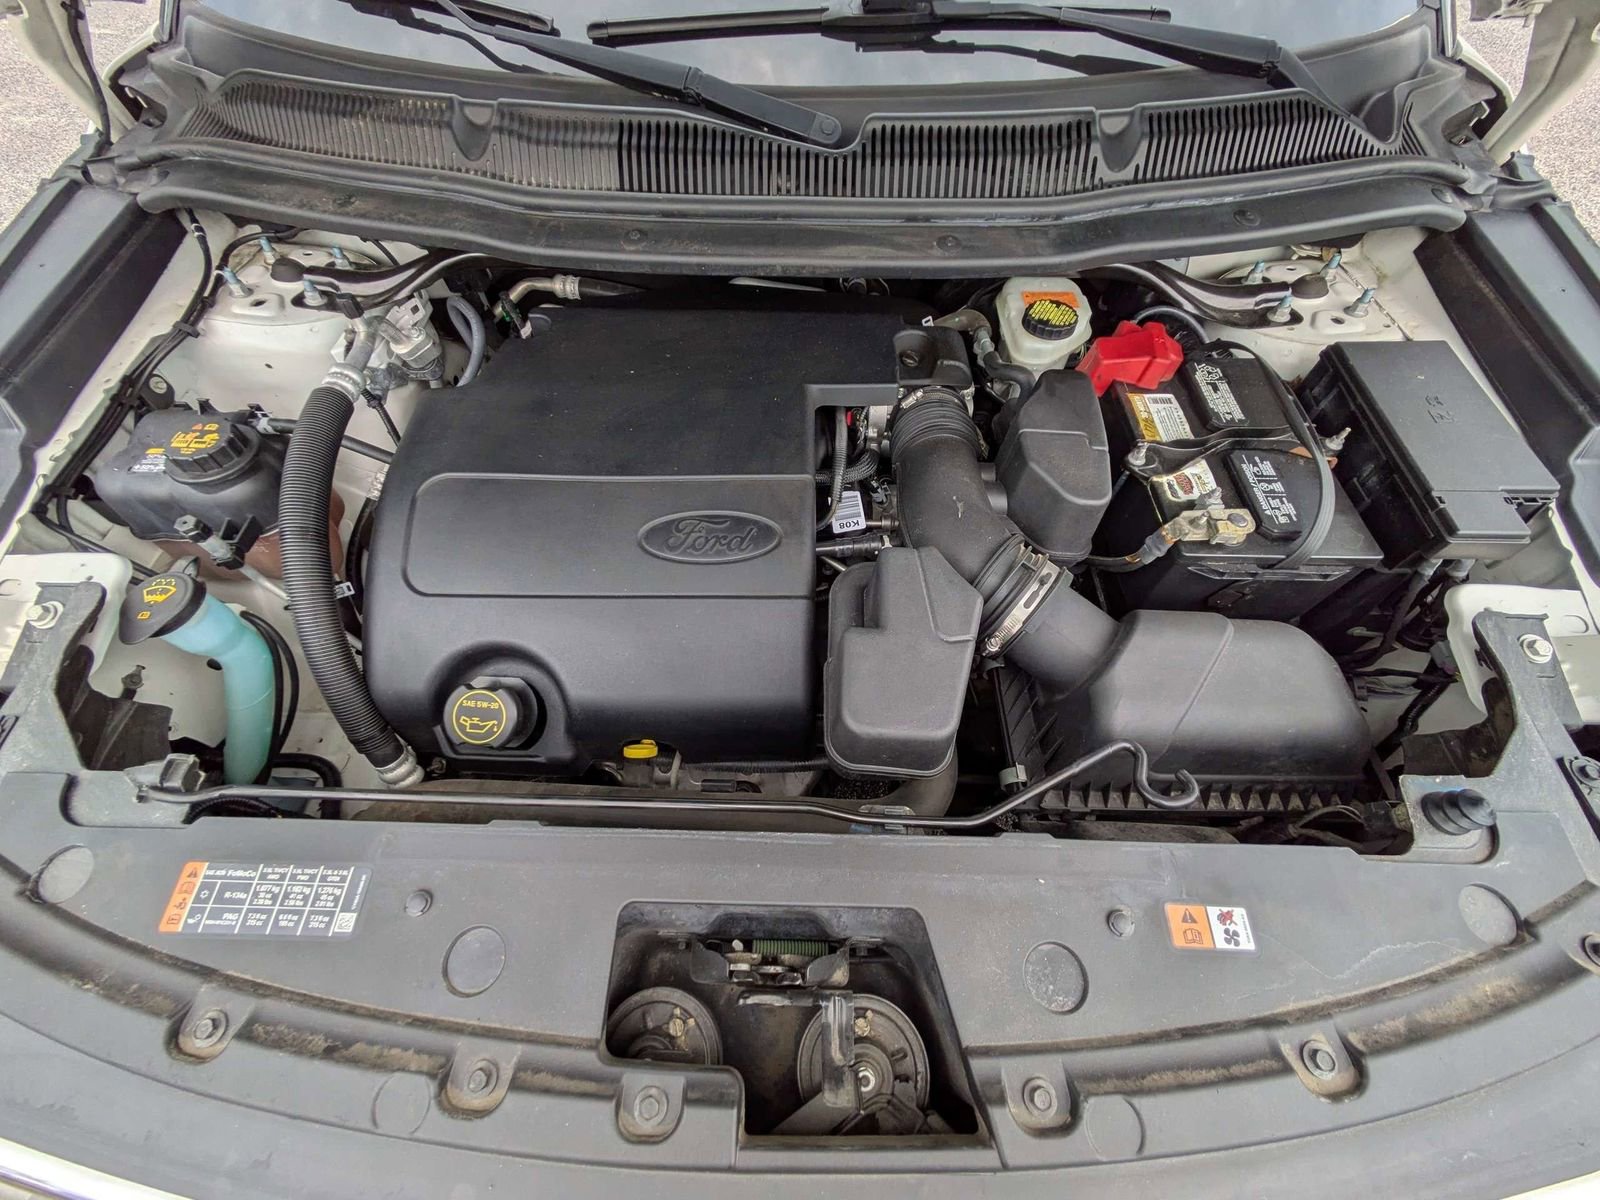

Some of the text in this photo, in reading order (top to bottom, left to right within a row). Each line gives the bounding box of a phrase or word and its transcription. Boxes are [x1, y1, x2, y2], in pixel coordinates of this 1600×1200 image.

[838, 519, 860, 530] K08
[664, 517, 758, 554] Ford
[477, 701, 499, 709] 5W-20
[224, 891, 248, 899] R-134a
